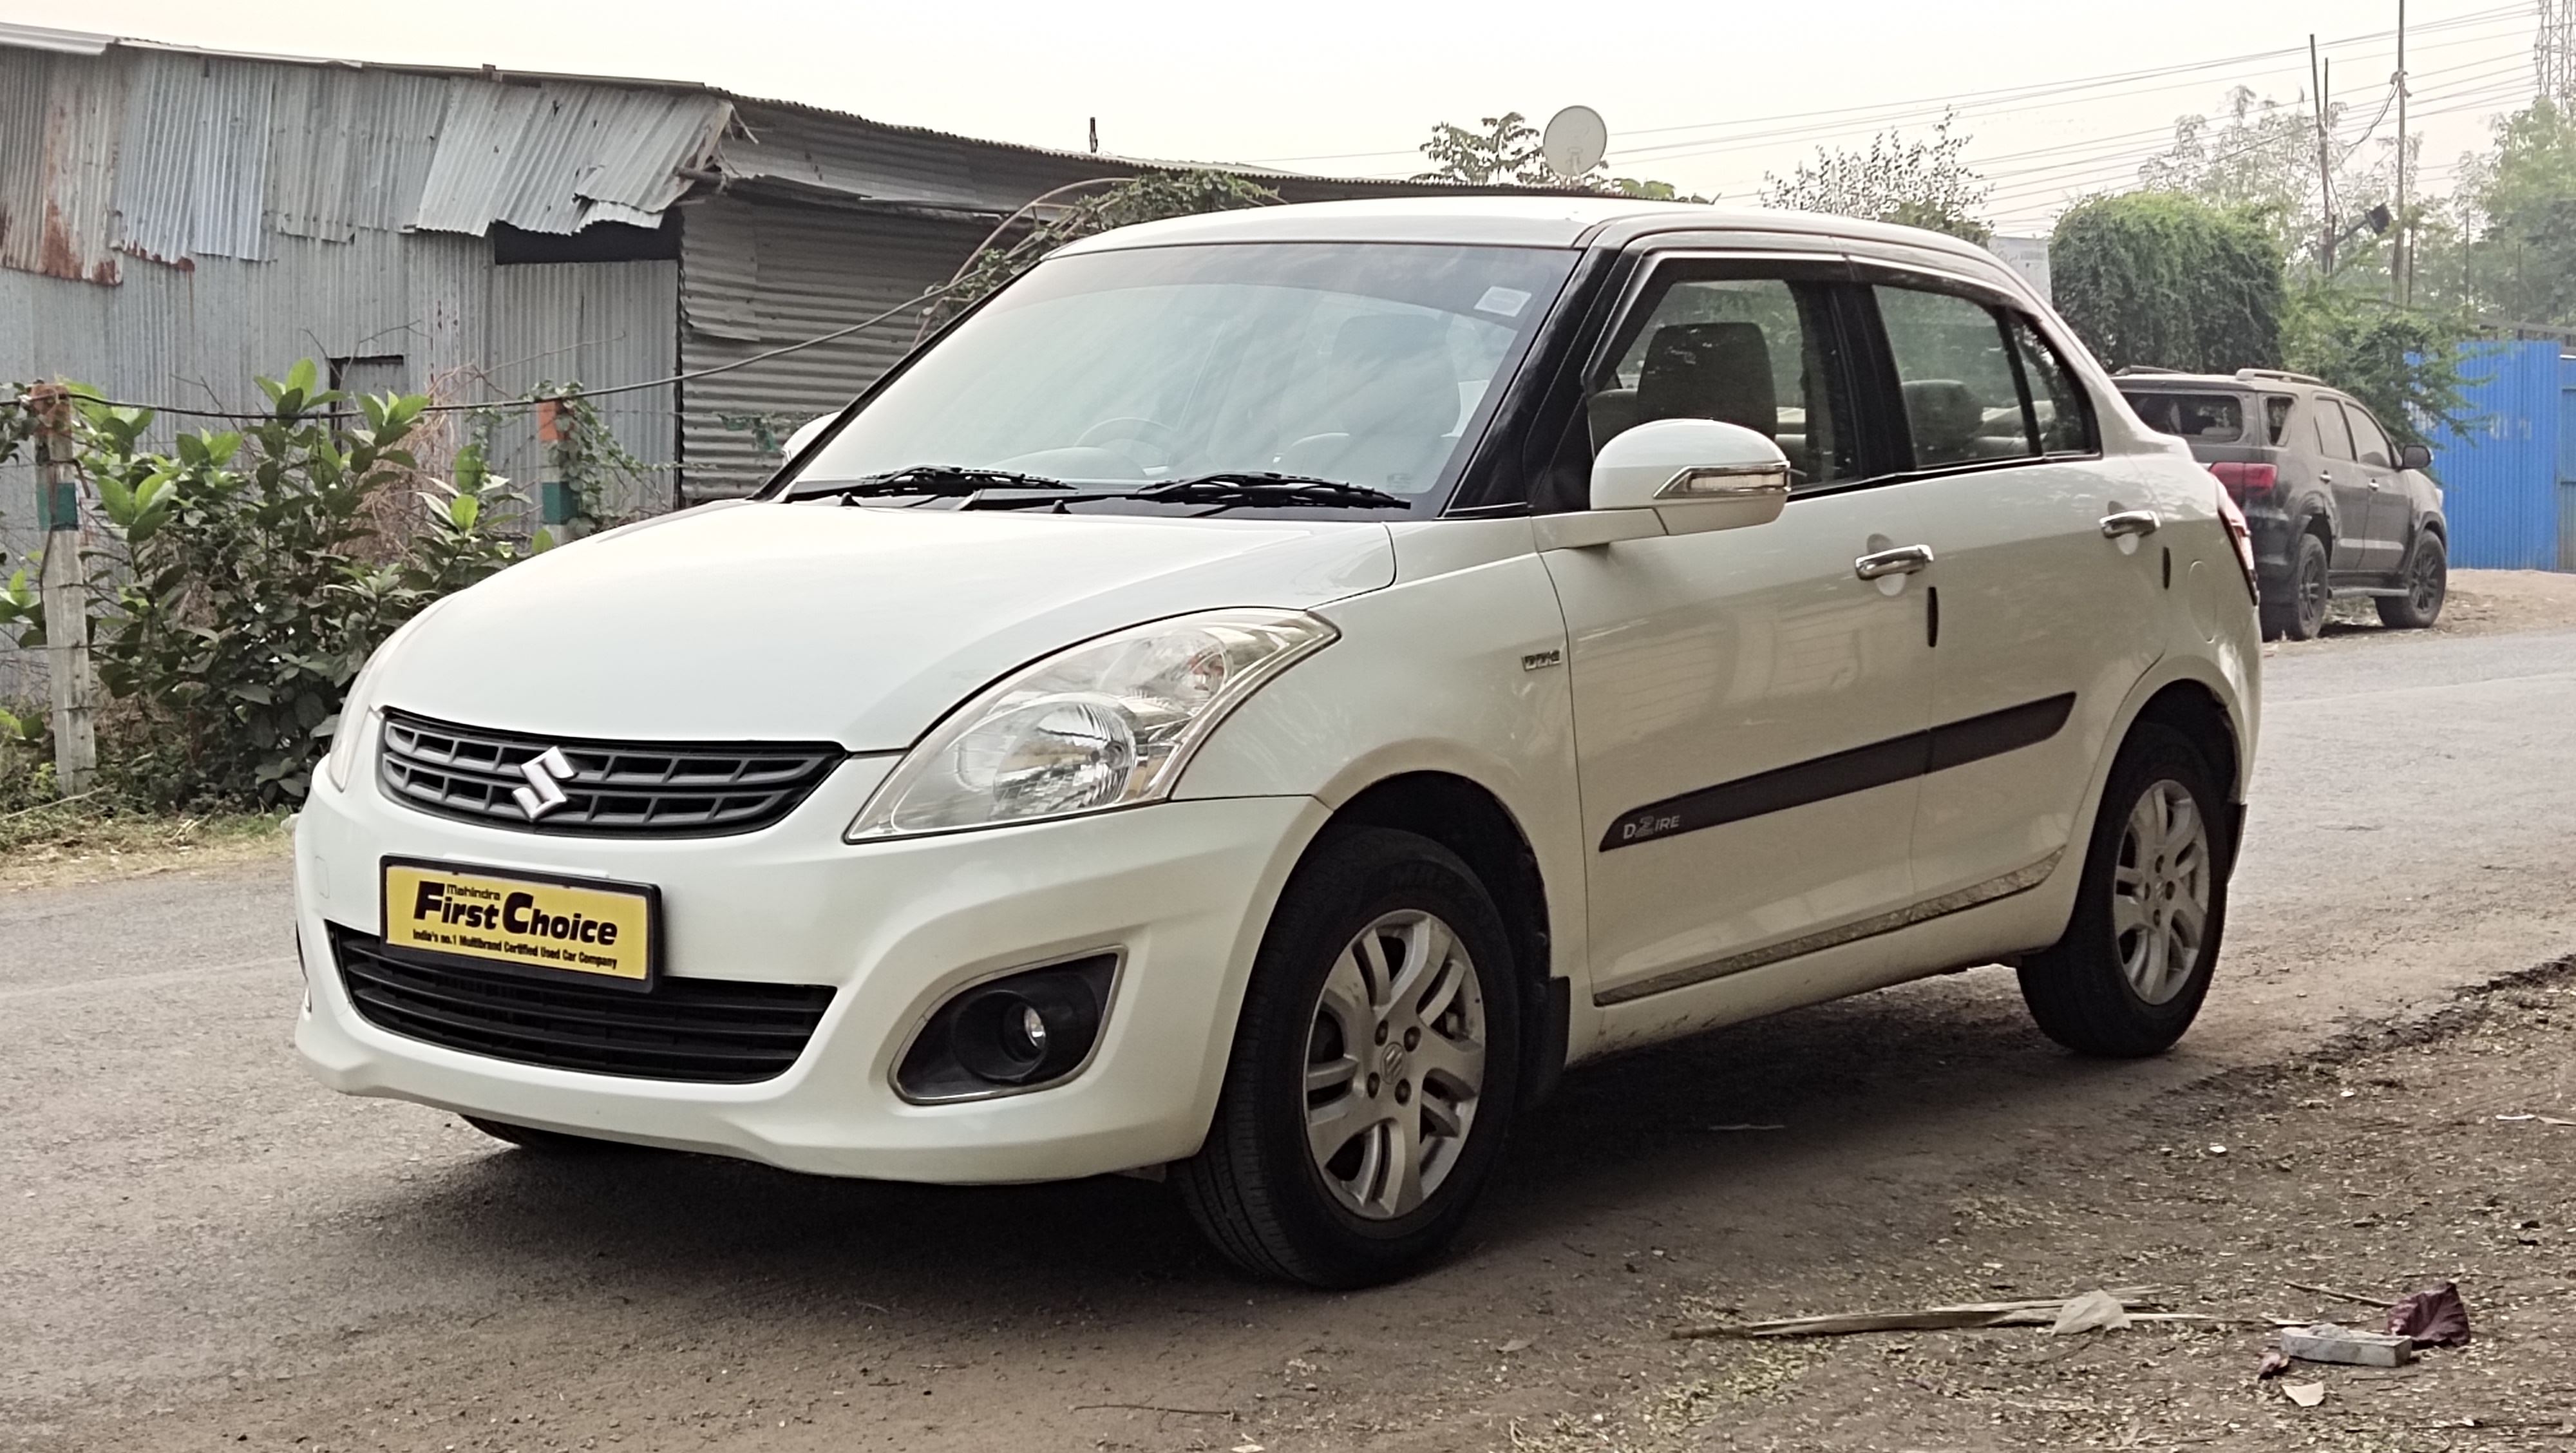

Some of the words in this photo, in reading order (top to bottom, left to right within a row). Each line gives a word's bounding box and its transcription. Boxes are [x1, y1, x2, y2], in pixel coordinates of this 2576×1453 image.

[447, 884, 500, 900] Mahindra
[413, 880, 500, 930] First
[502, 891, 618, 945] Choice
[413, 929, 439, 943] India's
[459, 935, 501, 951] Multibrand
[504, 941, 538, 956] Certified
[540, 947, 560, 960] Used
[562, 949, 577, 962] Car
[578, 951, 618, 969] Company
